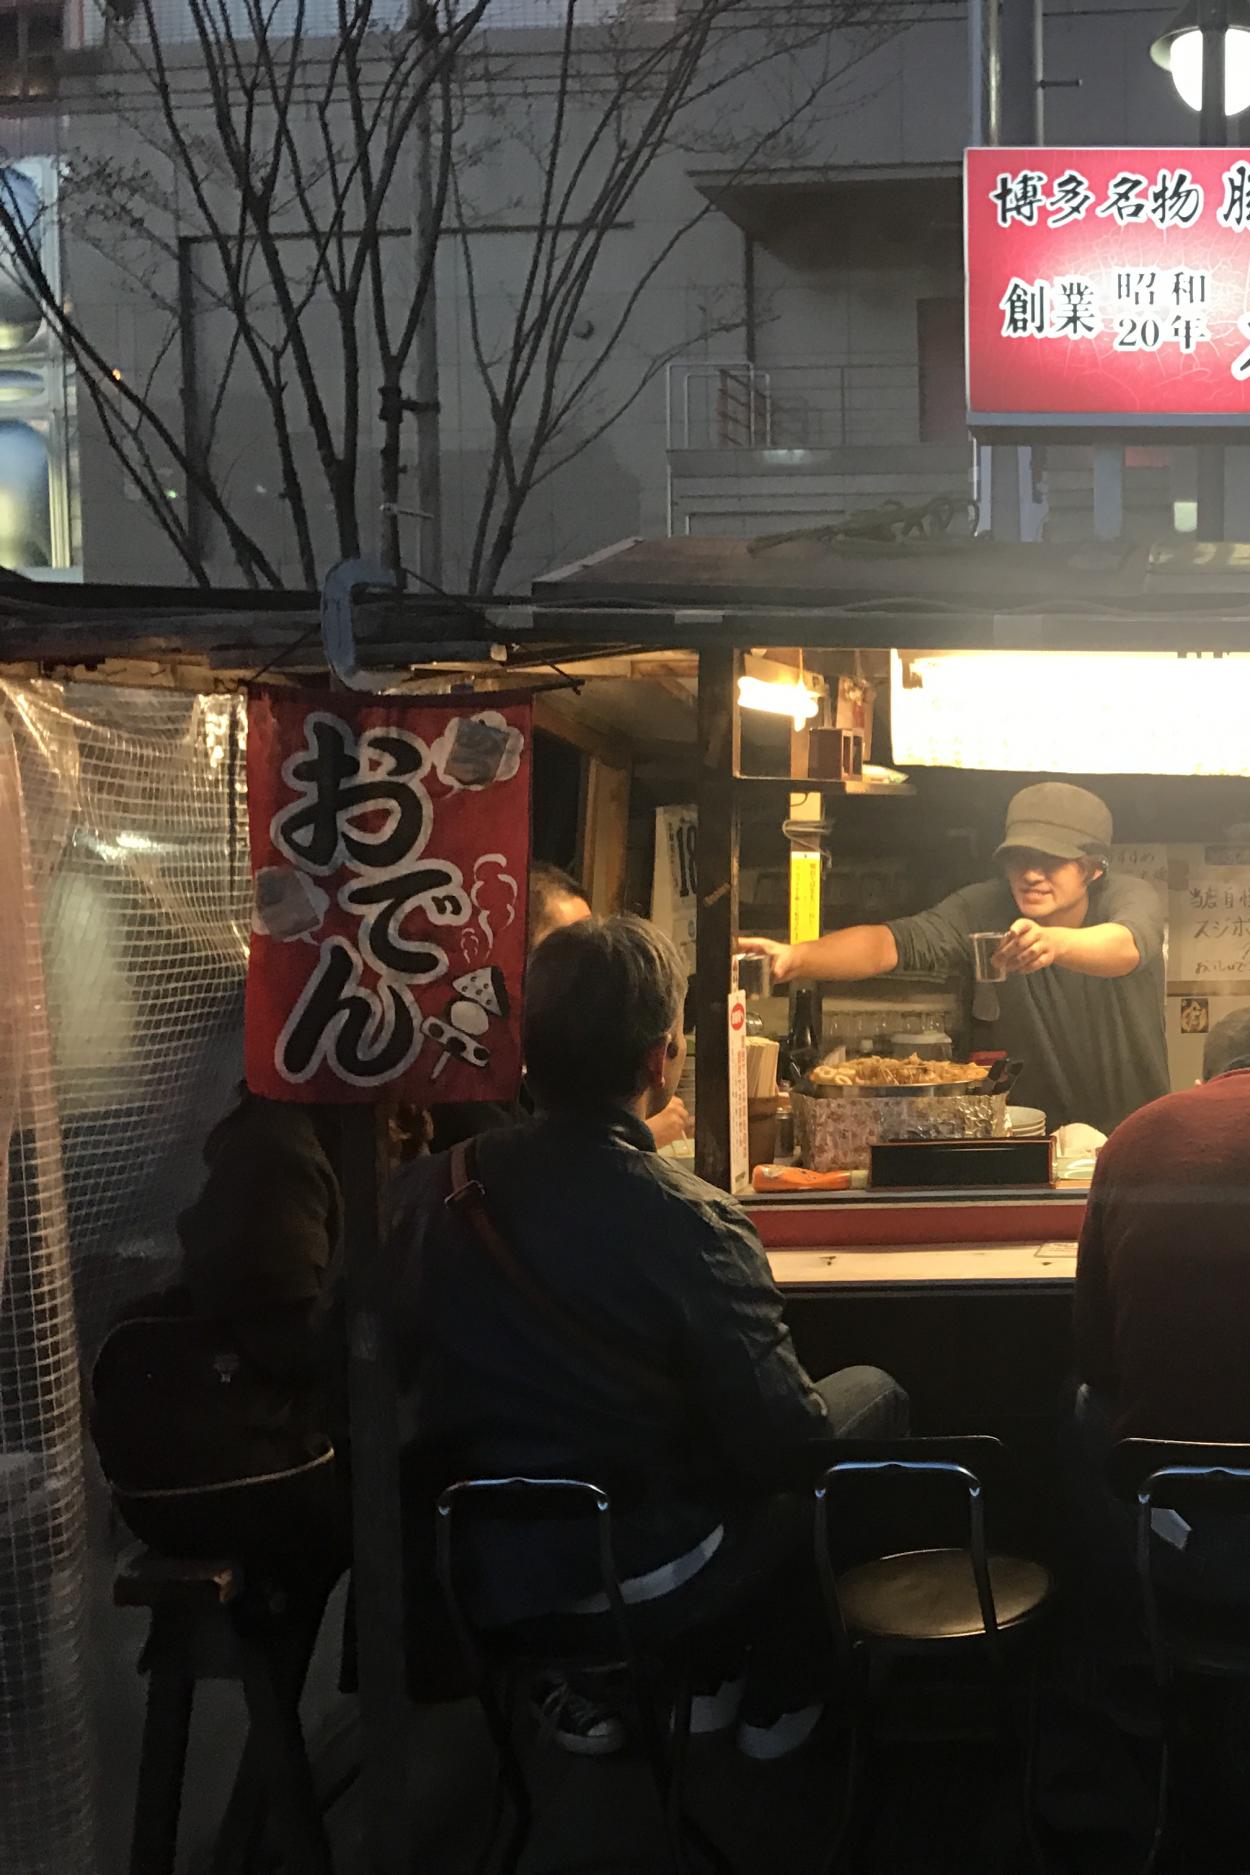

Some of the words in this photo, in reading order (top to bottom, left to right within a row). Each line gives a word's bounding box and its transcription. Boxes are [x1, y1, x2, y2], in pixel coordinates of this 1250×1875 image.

[1005, 282, 1096, 335] 創業
[1116, 270, 1206, 306] 昭和
[275, 712, 467, 1086] おでん
